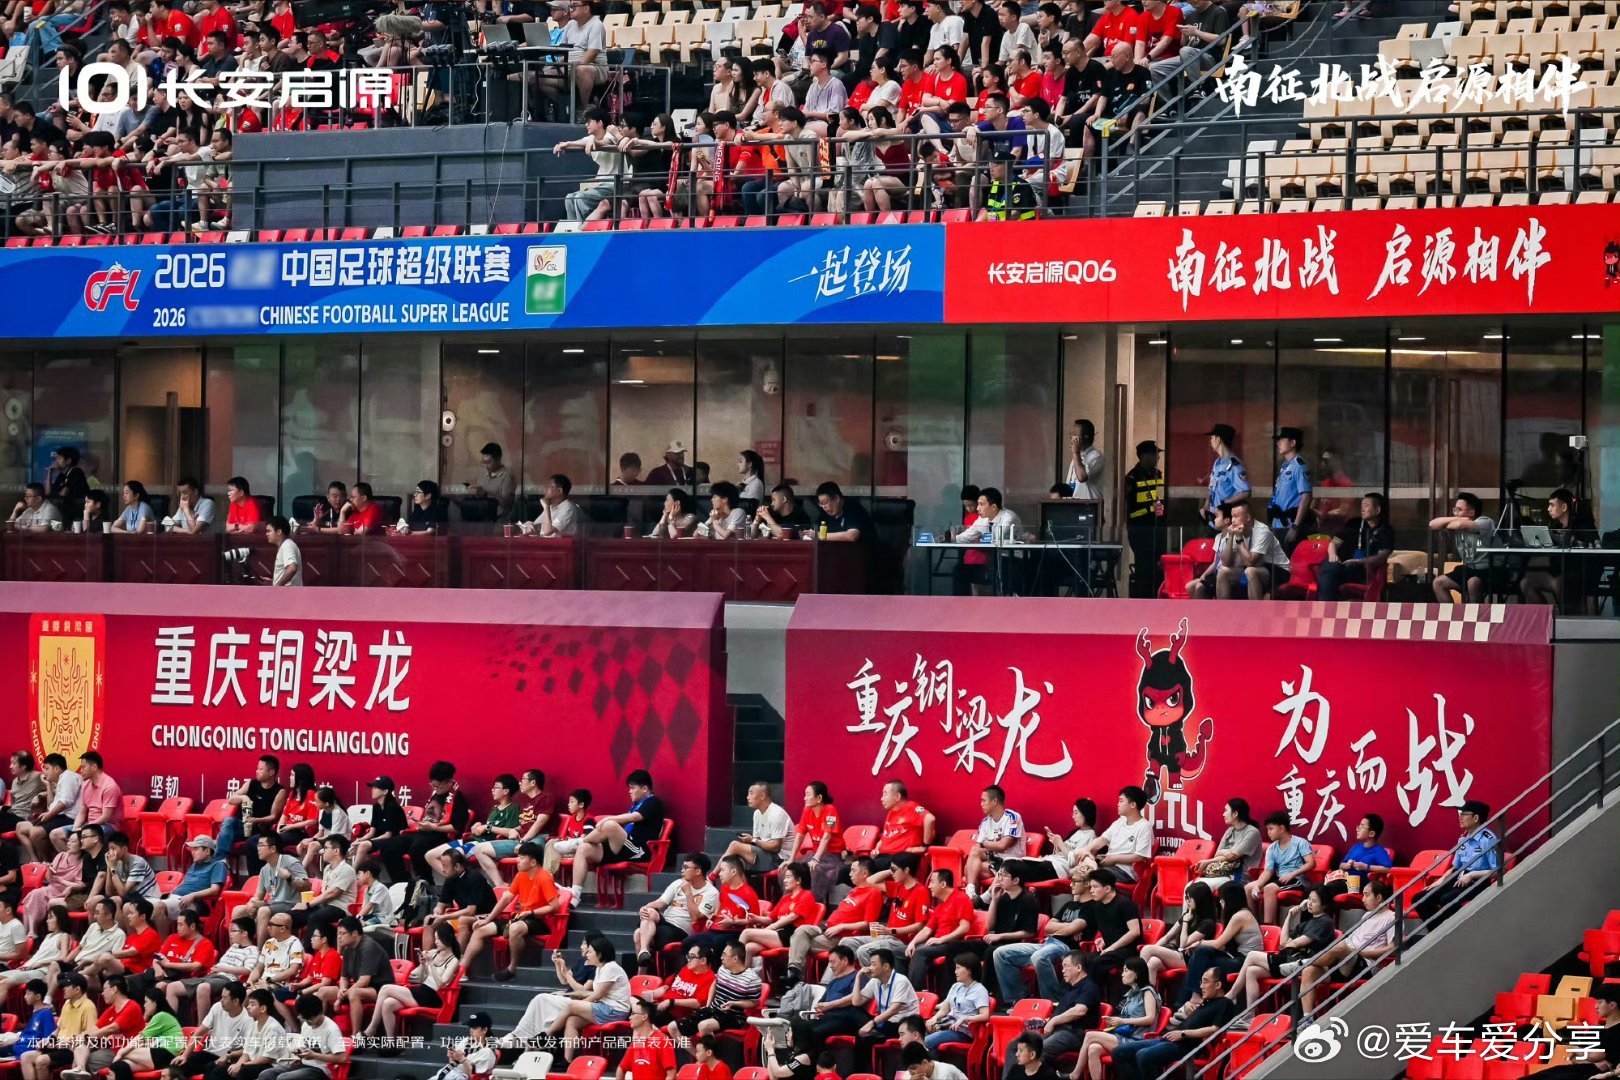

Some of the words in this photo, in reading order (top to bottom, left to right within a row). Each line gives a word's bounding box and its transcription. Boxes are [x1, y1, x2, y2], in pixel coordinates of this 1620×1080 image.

[155, 253, 225, 288] 2026
[282, 245, 510, 287] 中国足球超级联赛
[788, 243, 912, 301] 一起登场
[988, 260, 1117, 285] 长安启源Q06
[1167, 224, 1340, 313] 南征北战
[1366, 217, 1552, 306] 启源相伴
[153, 308, 185, 327] 2026
[260, 305, 318, 325] CHINESE
[323, 304, 396, 324] FOOTBALL
[401, 303, 447, 323] SUPER
[452, 302, 509, 322] LEAGUE
[151, 626, 413, 711] 重庆铜梁龙
[151, 724, 256, 751] CHONGQING
[260, 727, 409, 756] TONGLIANGLONG
[846, 652, 1073, 785] 重庆铜梁龙
[151, 775, 179, 800] 坚韧
